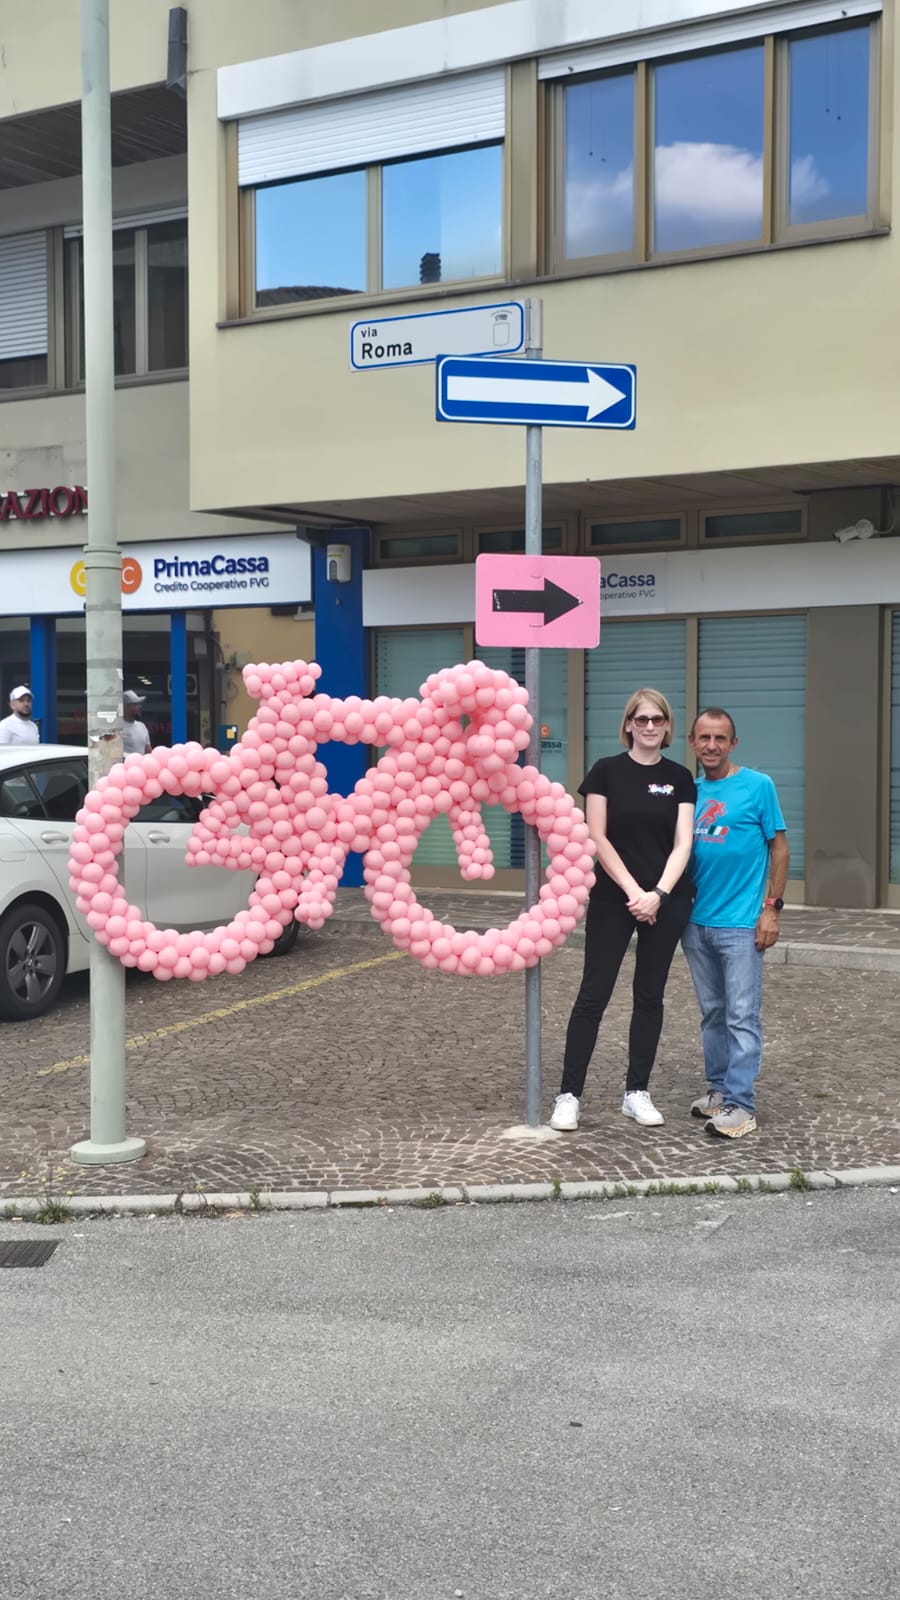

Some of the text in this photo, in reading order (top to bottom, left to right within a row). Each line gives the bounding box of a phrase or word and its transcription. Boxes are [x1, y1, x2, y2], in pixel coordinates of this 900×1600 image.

[361, 326, 377, 338] via
[362, 342, 413, 360] Roma
[153, 555, 270, 578] PrimaCassa
[154, 577, 270, 593] Credito Cooperativo FVG
[639, 589, 656, 598] FVG
